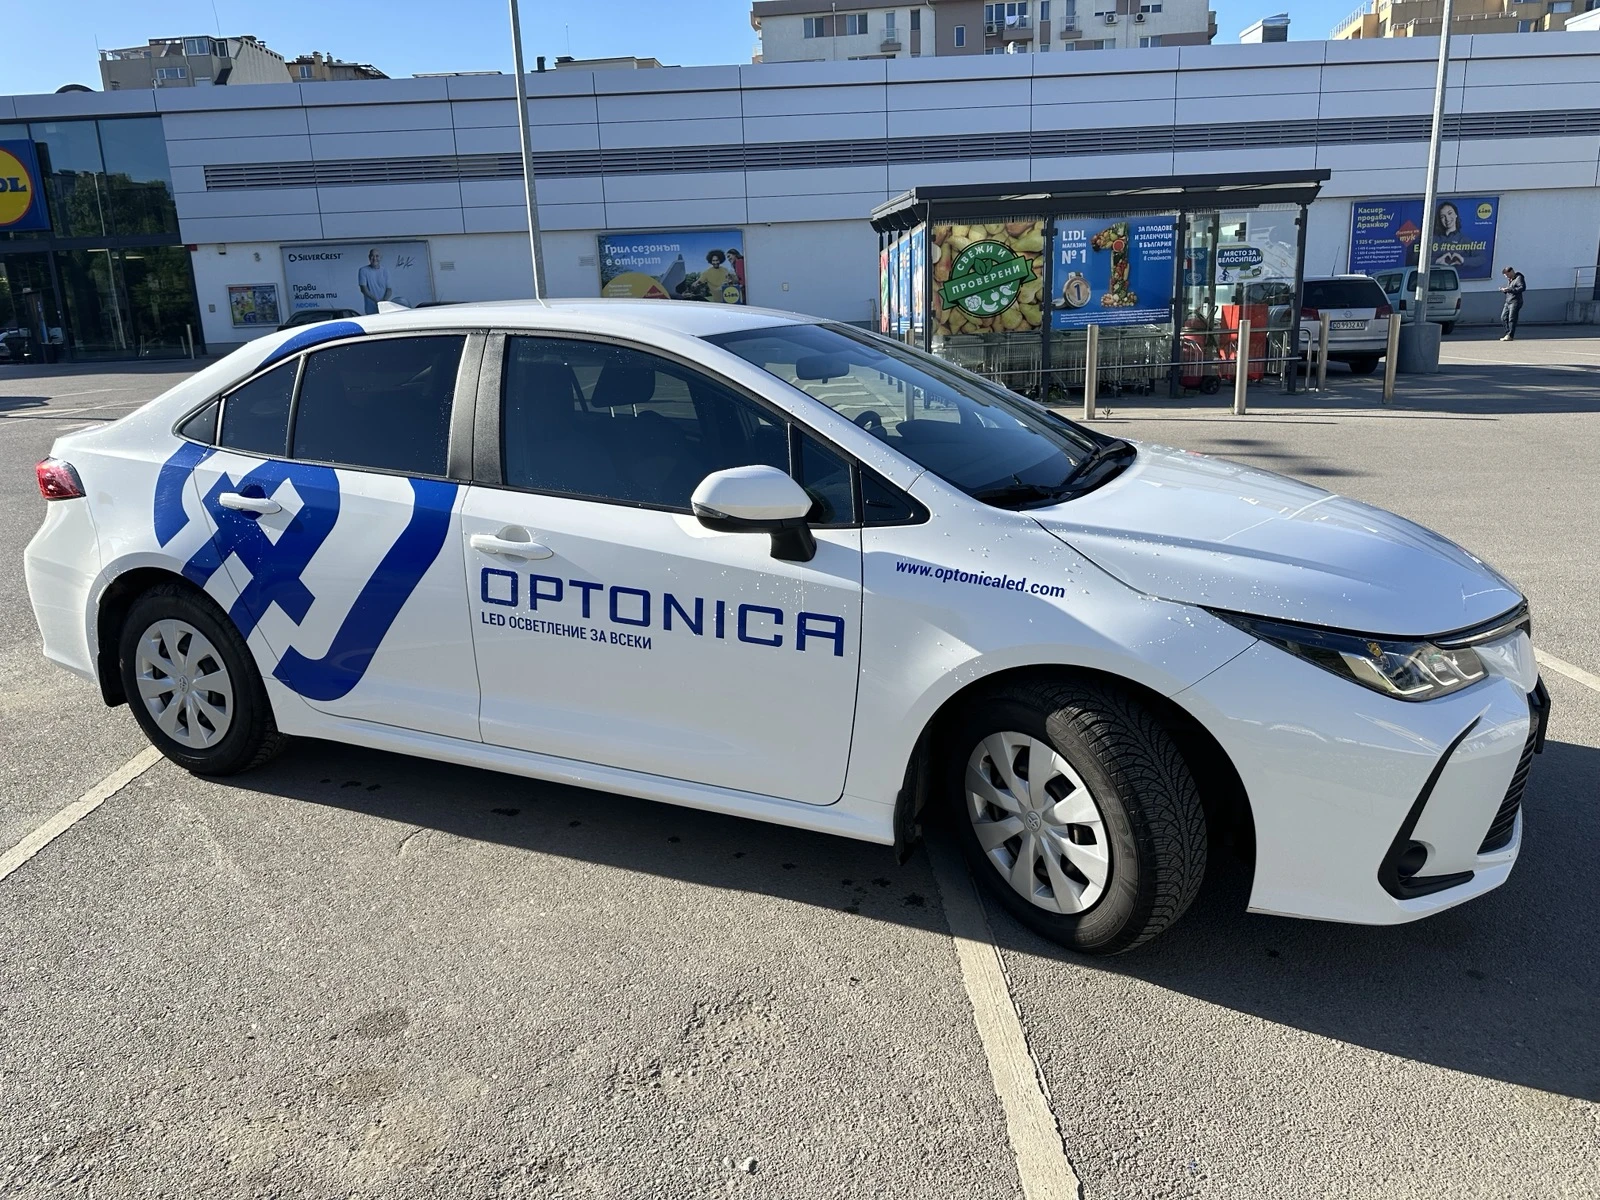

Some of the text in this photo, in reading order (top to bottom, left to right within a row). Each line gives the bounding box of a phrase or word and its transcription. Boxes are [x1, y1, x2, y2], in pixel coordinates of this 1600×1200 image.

[1358, 207, 1386, 215] Касиер-
[1357, 212, 1394, 222] продавач/
[1356, 221, 1389, 229] Аранжор
[1062, 230, 1087, 241] LIDL
[605, 243, 680, 256] Грил сезонът
[1440, 241, 1487, 252] #teamlidl
[615, 255, 661, 267] открит
[956, 245, 1006, 271] СВЕЖИ И
[951, 264, 1020, 294] ПРОВЕРЕНИ
[292, 283, 317, 293] Прави
[294, 292, 325, 300] живота
[896, 561, 1066, 598] www.optonicaled.com
[481, 567, 845, 657] OPTONICA
[481, 611, 652, 650] LED ОСВЕТЛЕНИЕ ЗА ВСЕКИ
